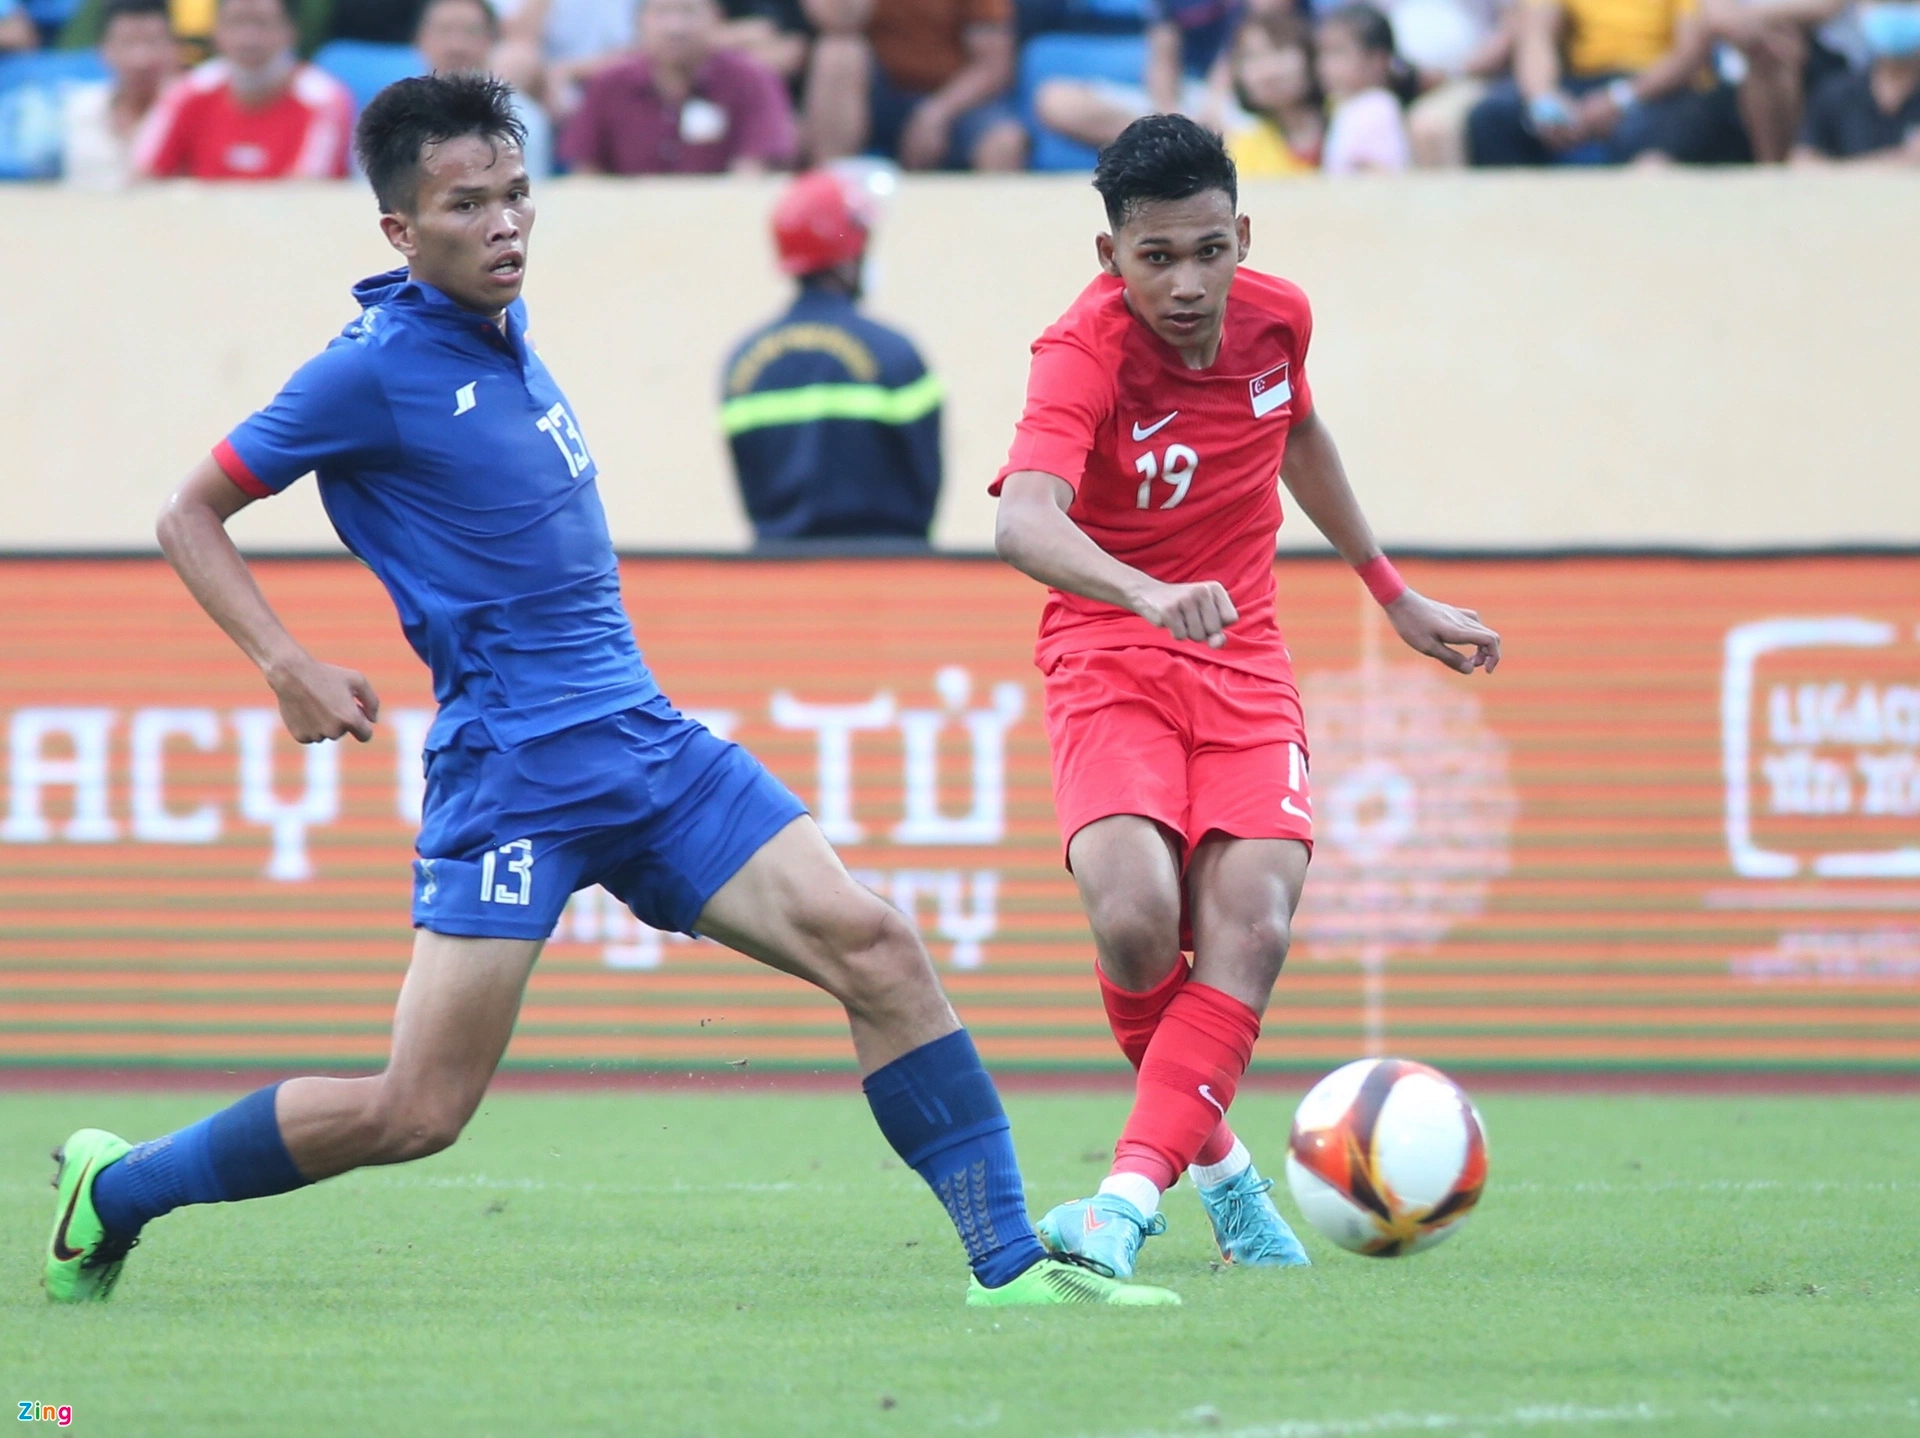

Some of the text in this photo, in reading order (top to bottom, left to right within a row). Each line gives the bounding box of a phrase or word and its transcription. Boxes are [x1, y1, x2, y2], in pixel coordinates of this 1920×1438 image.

[535, 402, 590, 479] 13
[1135, 443, 1199, 510] 19
[480, 838, 534, 906] 13
